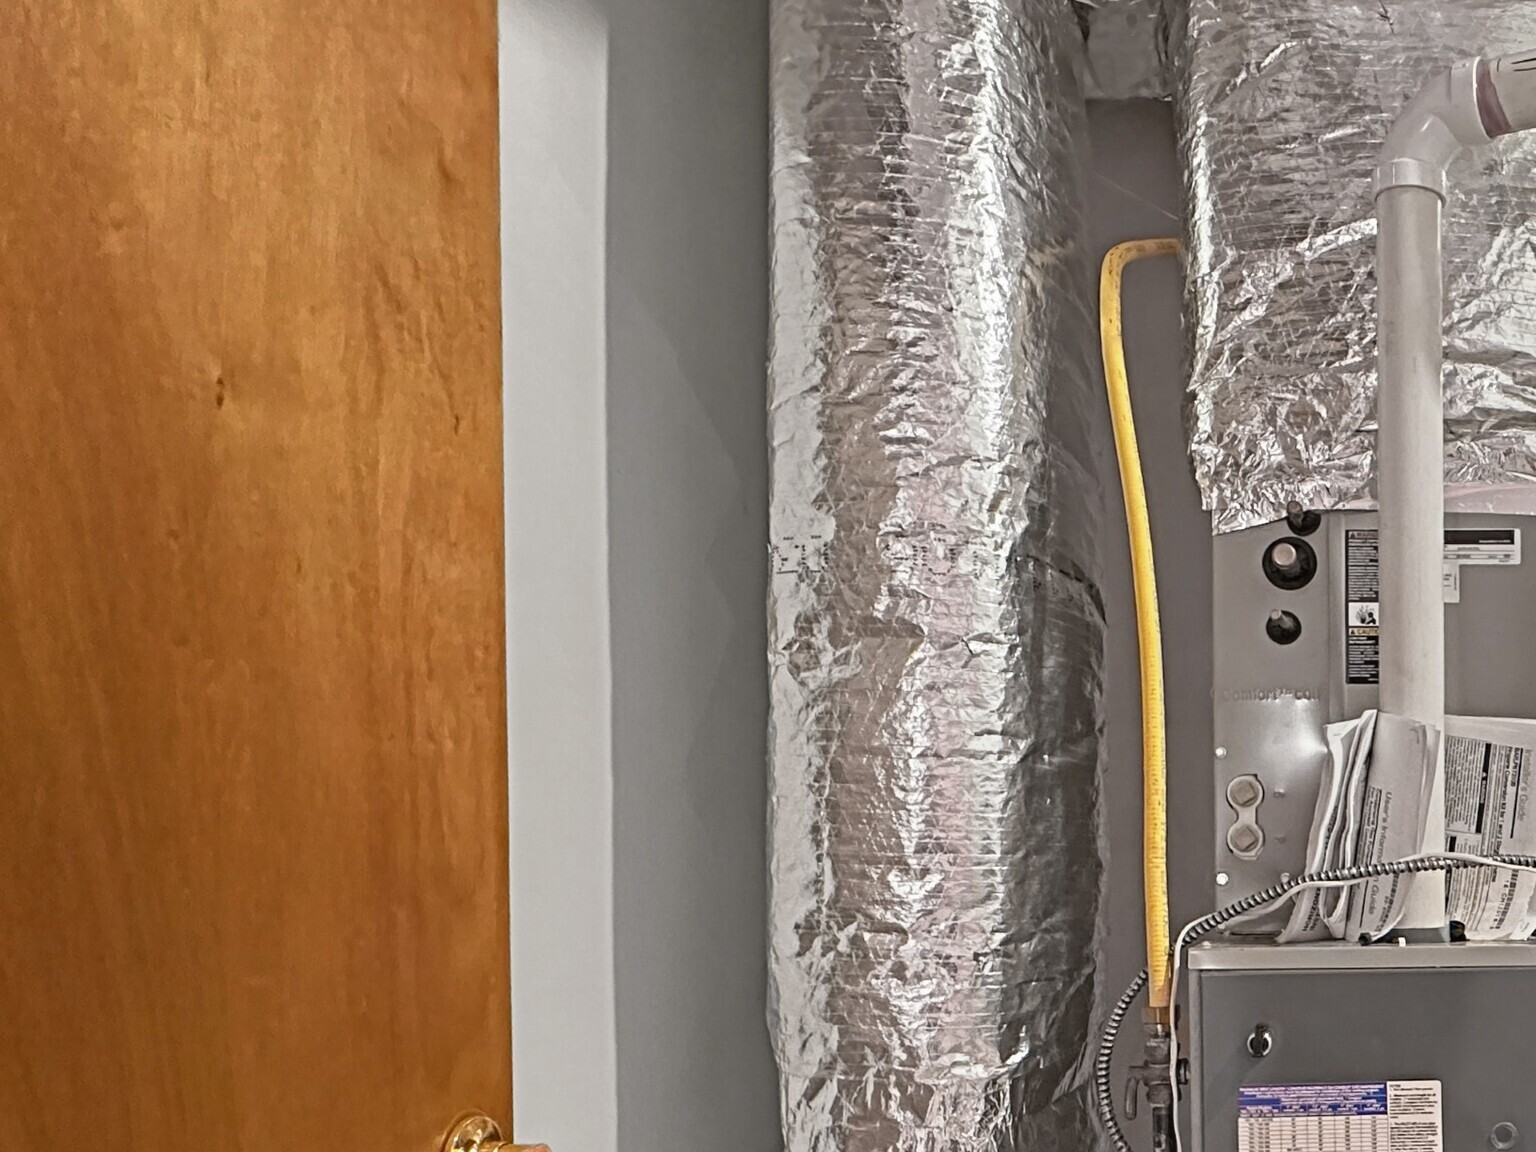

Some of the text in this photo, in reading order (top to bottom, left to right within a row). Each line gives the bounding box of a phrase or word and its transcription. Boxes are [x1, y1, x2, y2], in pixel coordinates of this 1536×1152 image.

[1382, 791, 1392, 823] User's
[1517, 794, 1529, 822] Guide
[1368, 885, 1378, 915] Guide
